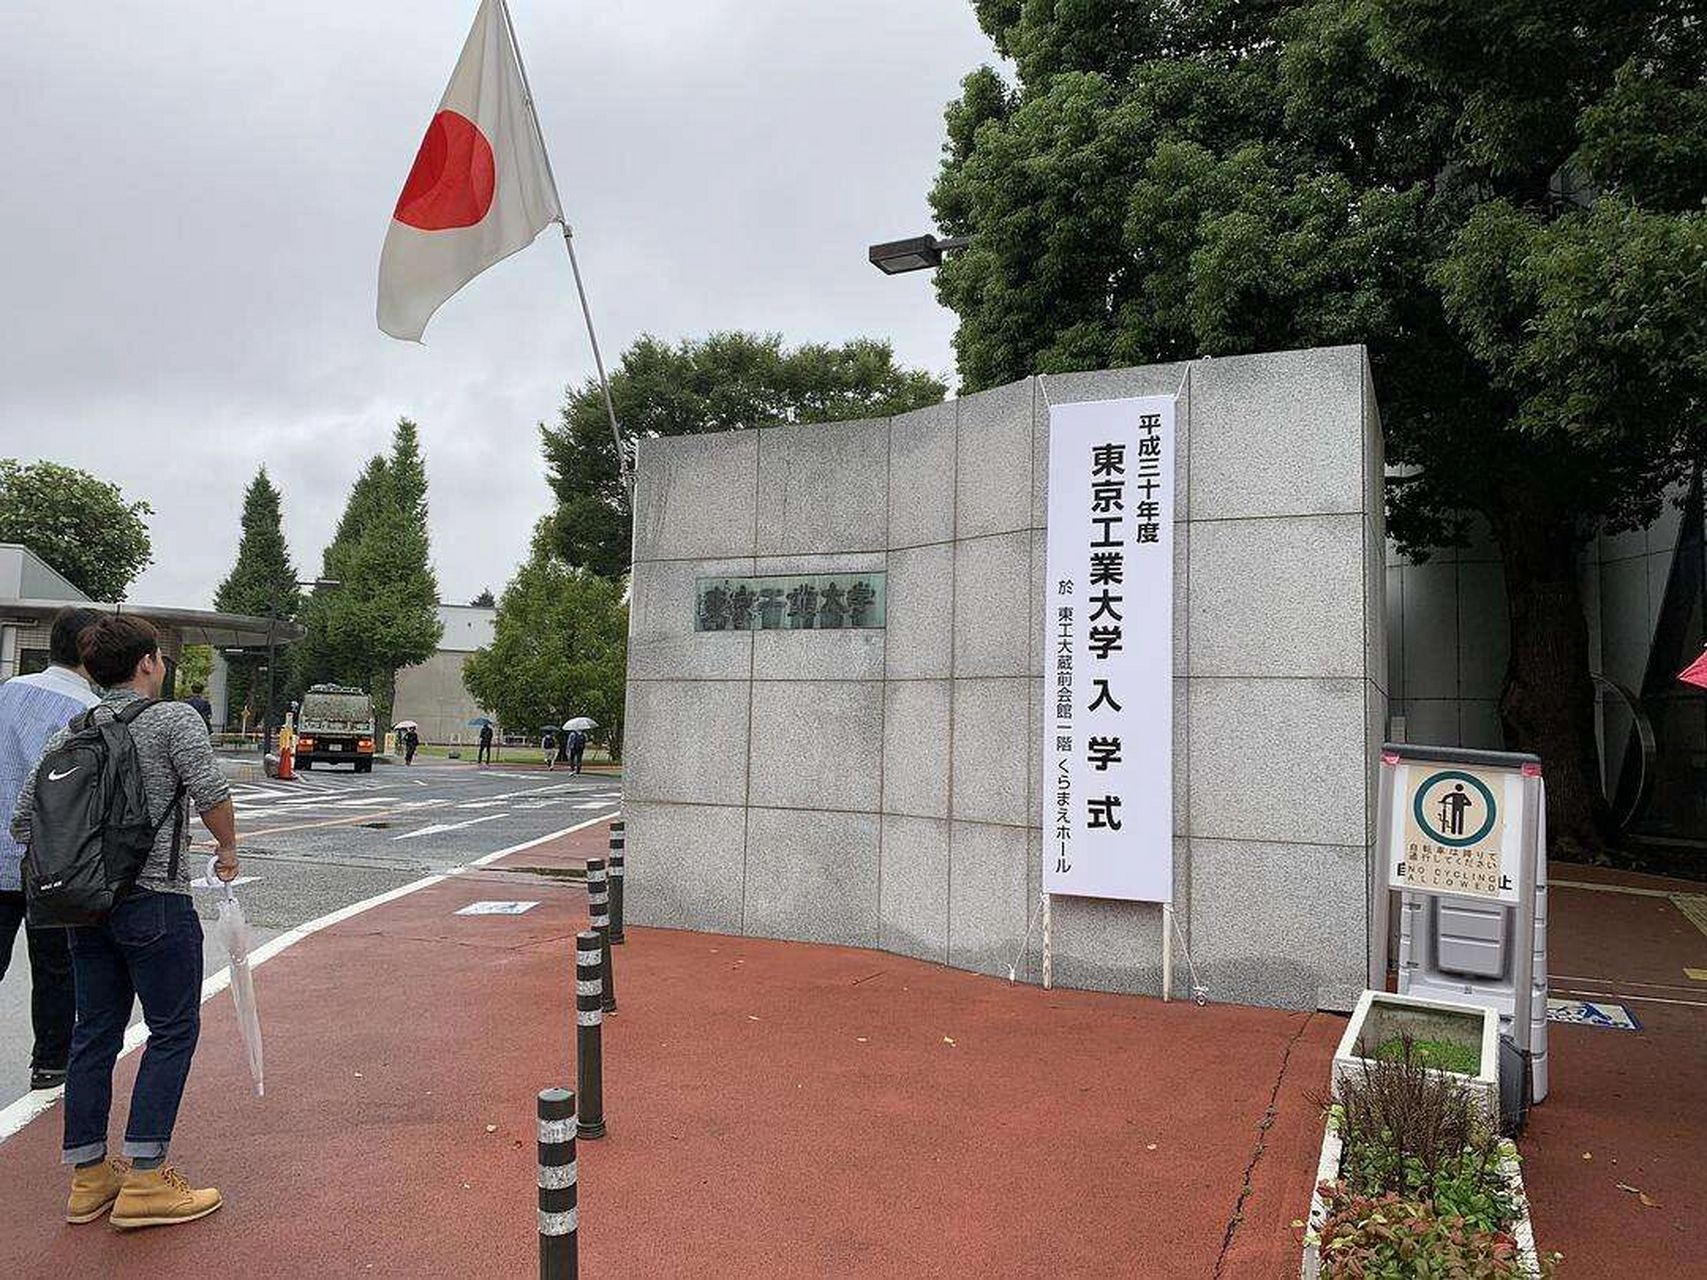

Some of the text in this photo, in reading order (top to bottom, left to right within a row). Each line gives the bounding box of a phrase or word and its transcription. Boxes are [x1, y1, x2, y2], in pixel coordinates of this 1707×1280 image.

[1136, 413, 1162, 544] 平成三十年度
[1088, 442, 1126, 661] 東京工業大学
[1407, 874, 1496, 892] ALLOWED
[1408, 865, 1425, 874] NO
[1434, 868, 1496, 883] CYCLING
